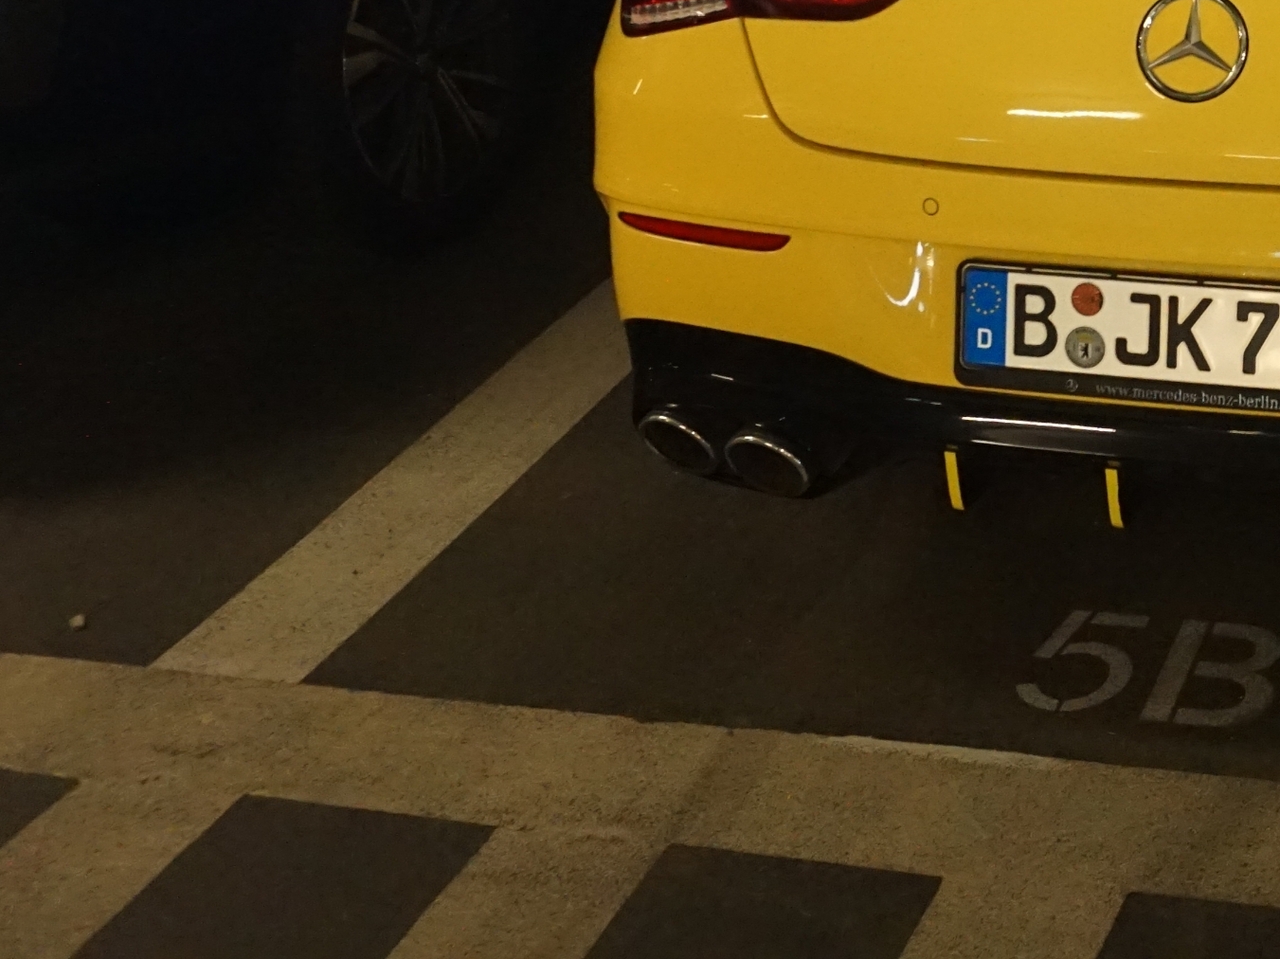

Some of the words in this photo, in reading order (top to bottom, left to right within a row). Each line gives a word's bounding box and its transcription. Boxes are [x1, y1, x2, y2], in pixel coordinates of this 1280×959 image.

[976, 327, 994, 350] D
[1013, 283, 1059, 357] B
[1115, 293, 1214, 373] JK
